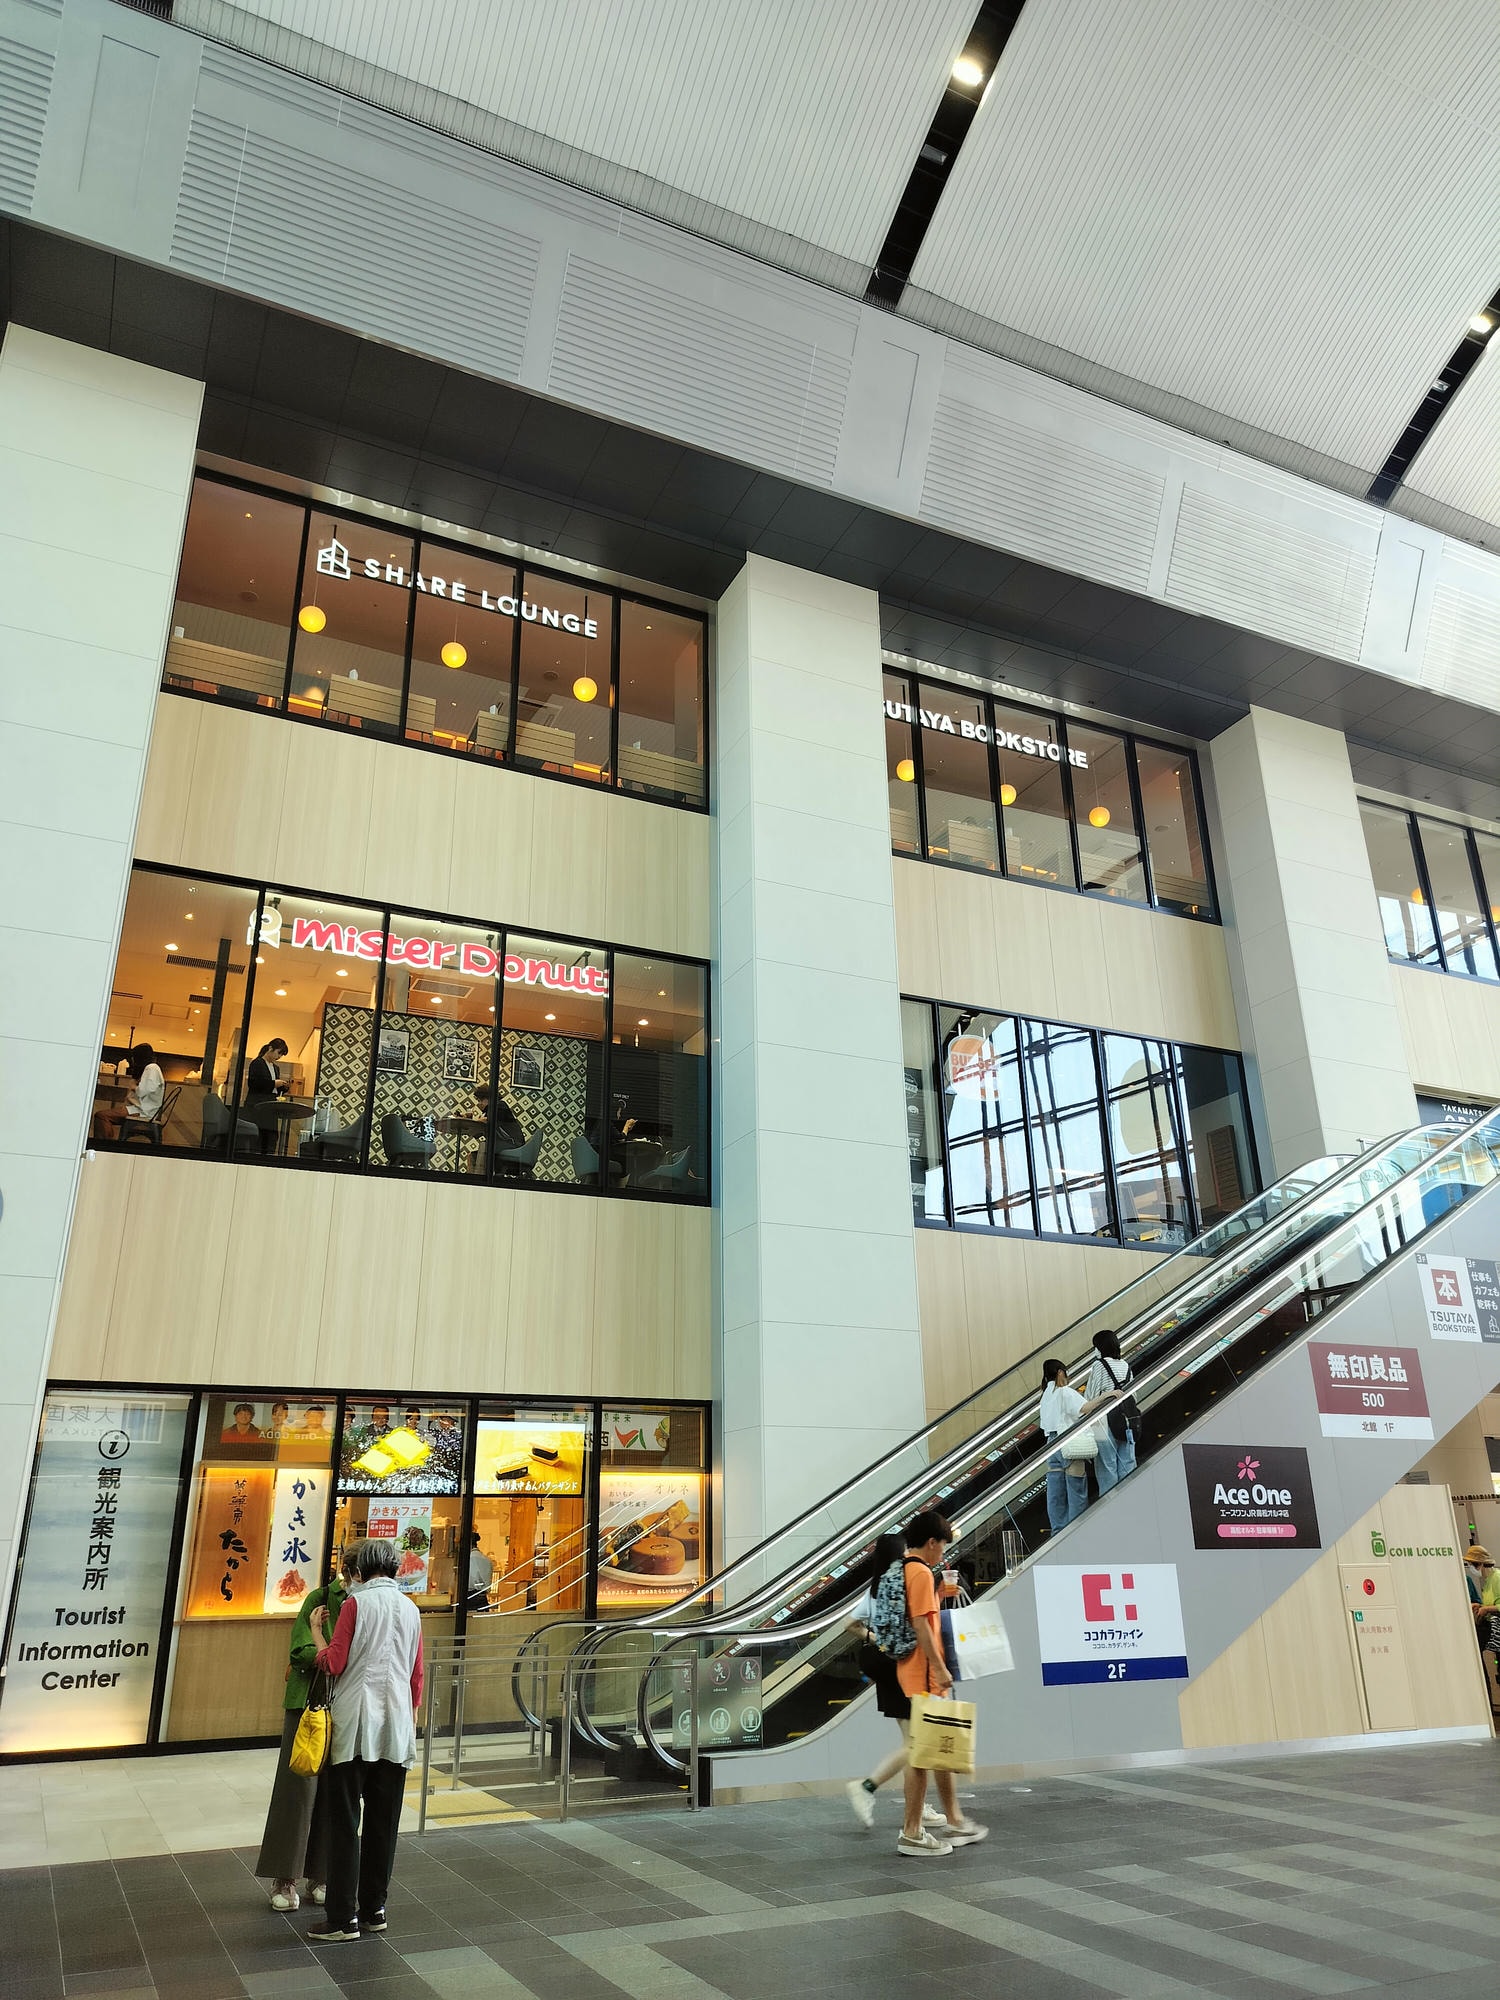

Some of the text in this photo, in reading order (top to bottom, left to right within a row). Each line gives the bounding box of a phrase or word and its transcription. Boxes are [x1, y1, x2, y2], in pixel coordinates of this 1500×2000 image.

[364, 559, 597, 638] SHARE LOUNGE
[961, 720, 1089, 769] BOOKSTORE
[1435, 1274, 1457, 1301] 本
[1474, 1285, 1500, 1297] カフェも
[1430, 1310, 1475, 1325] TSUTAYA
[1433, 1323, 1477, 1334] BOOKSTORE
[1327, 1351, 1408, 1383] 無印良品
[1362, 1392, 1385, 1408] 500
[1384, 1422, 1394, 1433] 1F
[1213, 1483, 1292, 1505] Ace One
[283, 1477, 316, 1564] かき氷
[372, 1506, 430, 1516] かき氷フェア
[82, 1467, 122, 1590] 観光案内所
[1389, 1547, 1454, 1557] COIN LOCKER
[219, 1529, 249, 1601] たから
[55, 1606, 126, 1626] Tourist
[1084, 1629, 1143, 1642] ココカラファイン
[18, 1640, 149, 1662] Information
[41, 1670, 120, 1691] Center
[1107, 1663, 1127, 1679] 2F
